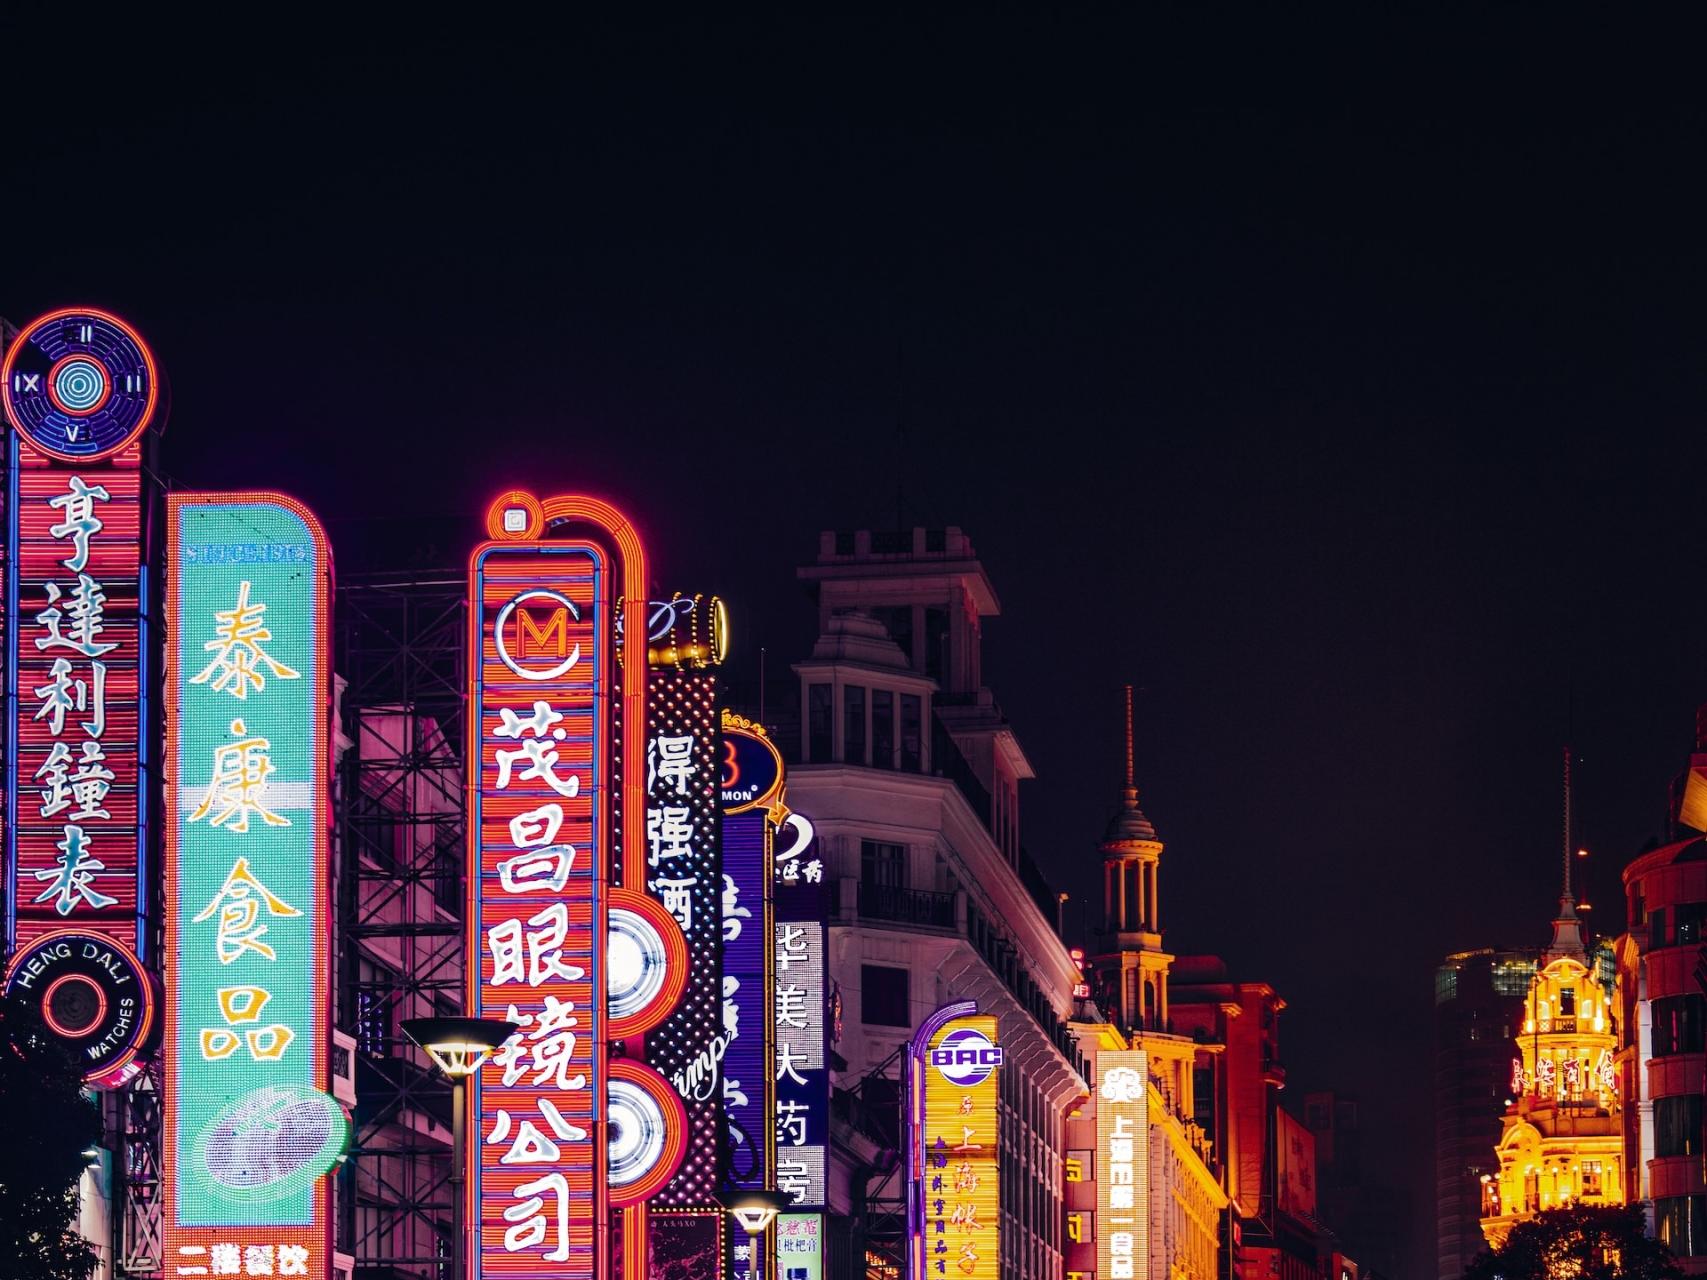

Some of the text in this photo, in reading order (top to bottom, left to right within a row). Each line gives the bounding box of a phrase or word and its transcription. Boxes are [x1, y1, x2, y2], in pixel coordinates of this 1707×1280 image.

[34, 476, 120, 916] 亨達利鐘表
[188, 581, 304, 1060] 泰康食品
[776, 859, 824, 883] 医药
[17, 943, 131, 989] HENG DALI
[488, 700, 586, 1261] 茂昌眼镜公司
[87, 998, 135, 1060] WATCHES
[932, 1048, 1003, 1066] BAC
